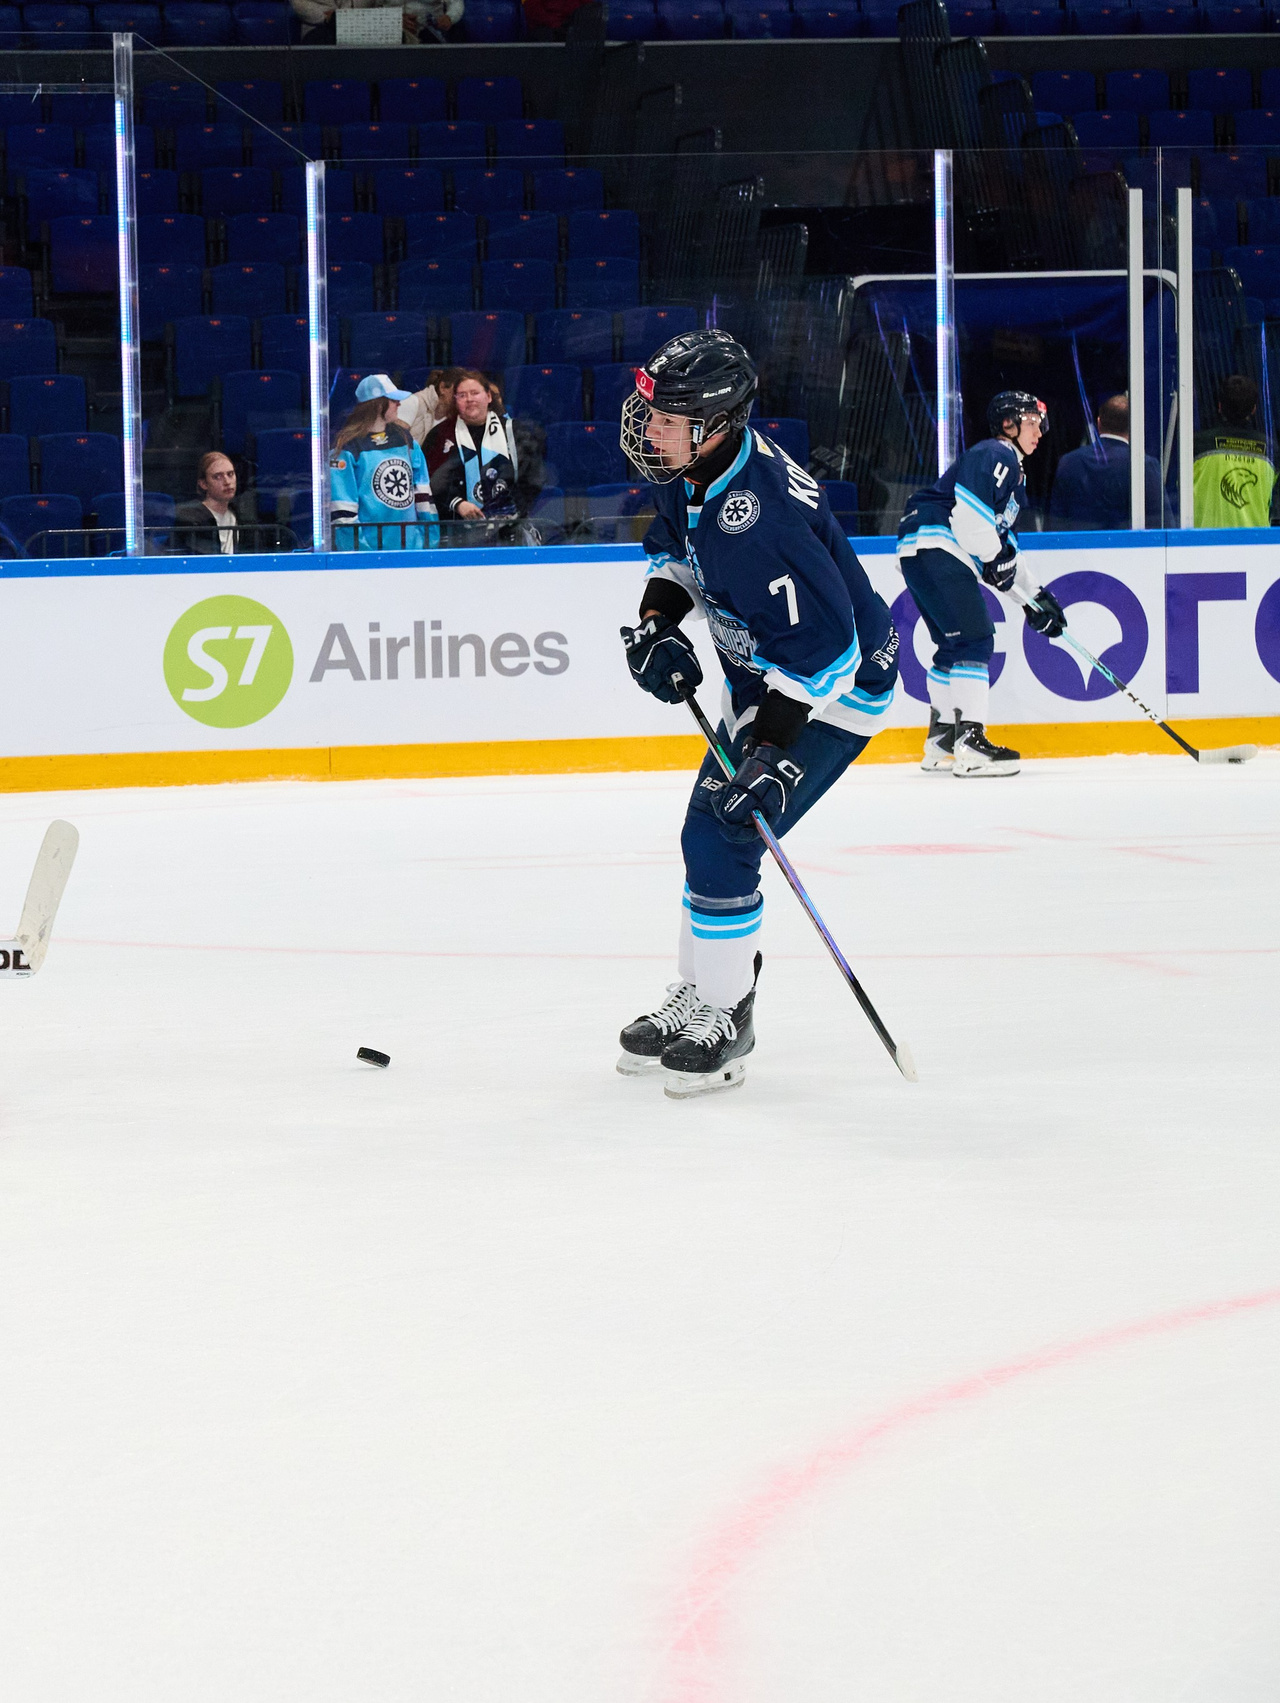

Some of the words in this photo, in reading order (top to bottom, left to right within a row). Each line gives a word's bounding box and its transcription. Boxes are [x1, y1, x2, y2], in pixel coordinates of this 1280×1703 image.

[993, 462, 1009, 488] 4
[768, 574, 800, 626] 7
[181, 624, 273, 702] S7
[309, 619, 570, 683] Airlines
[889, 570, 1280, 705] СОГ
